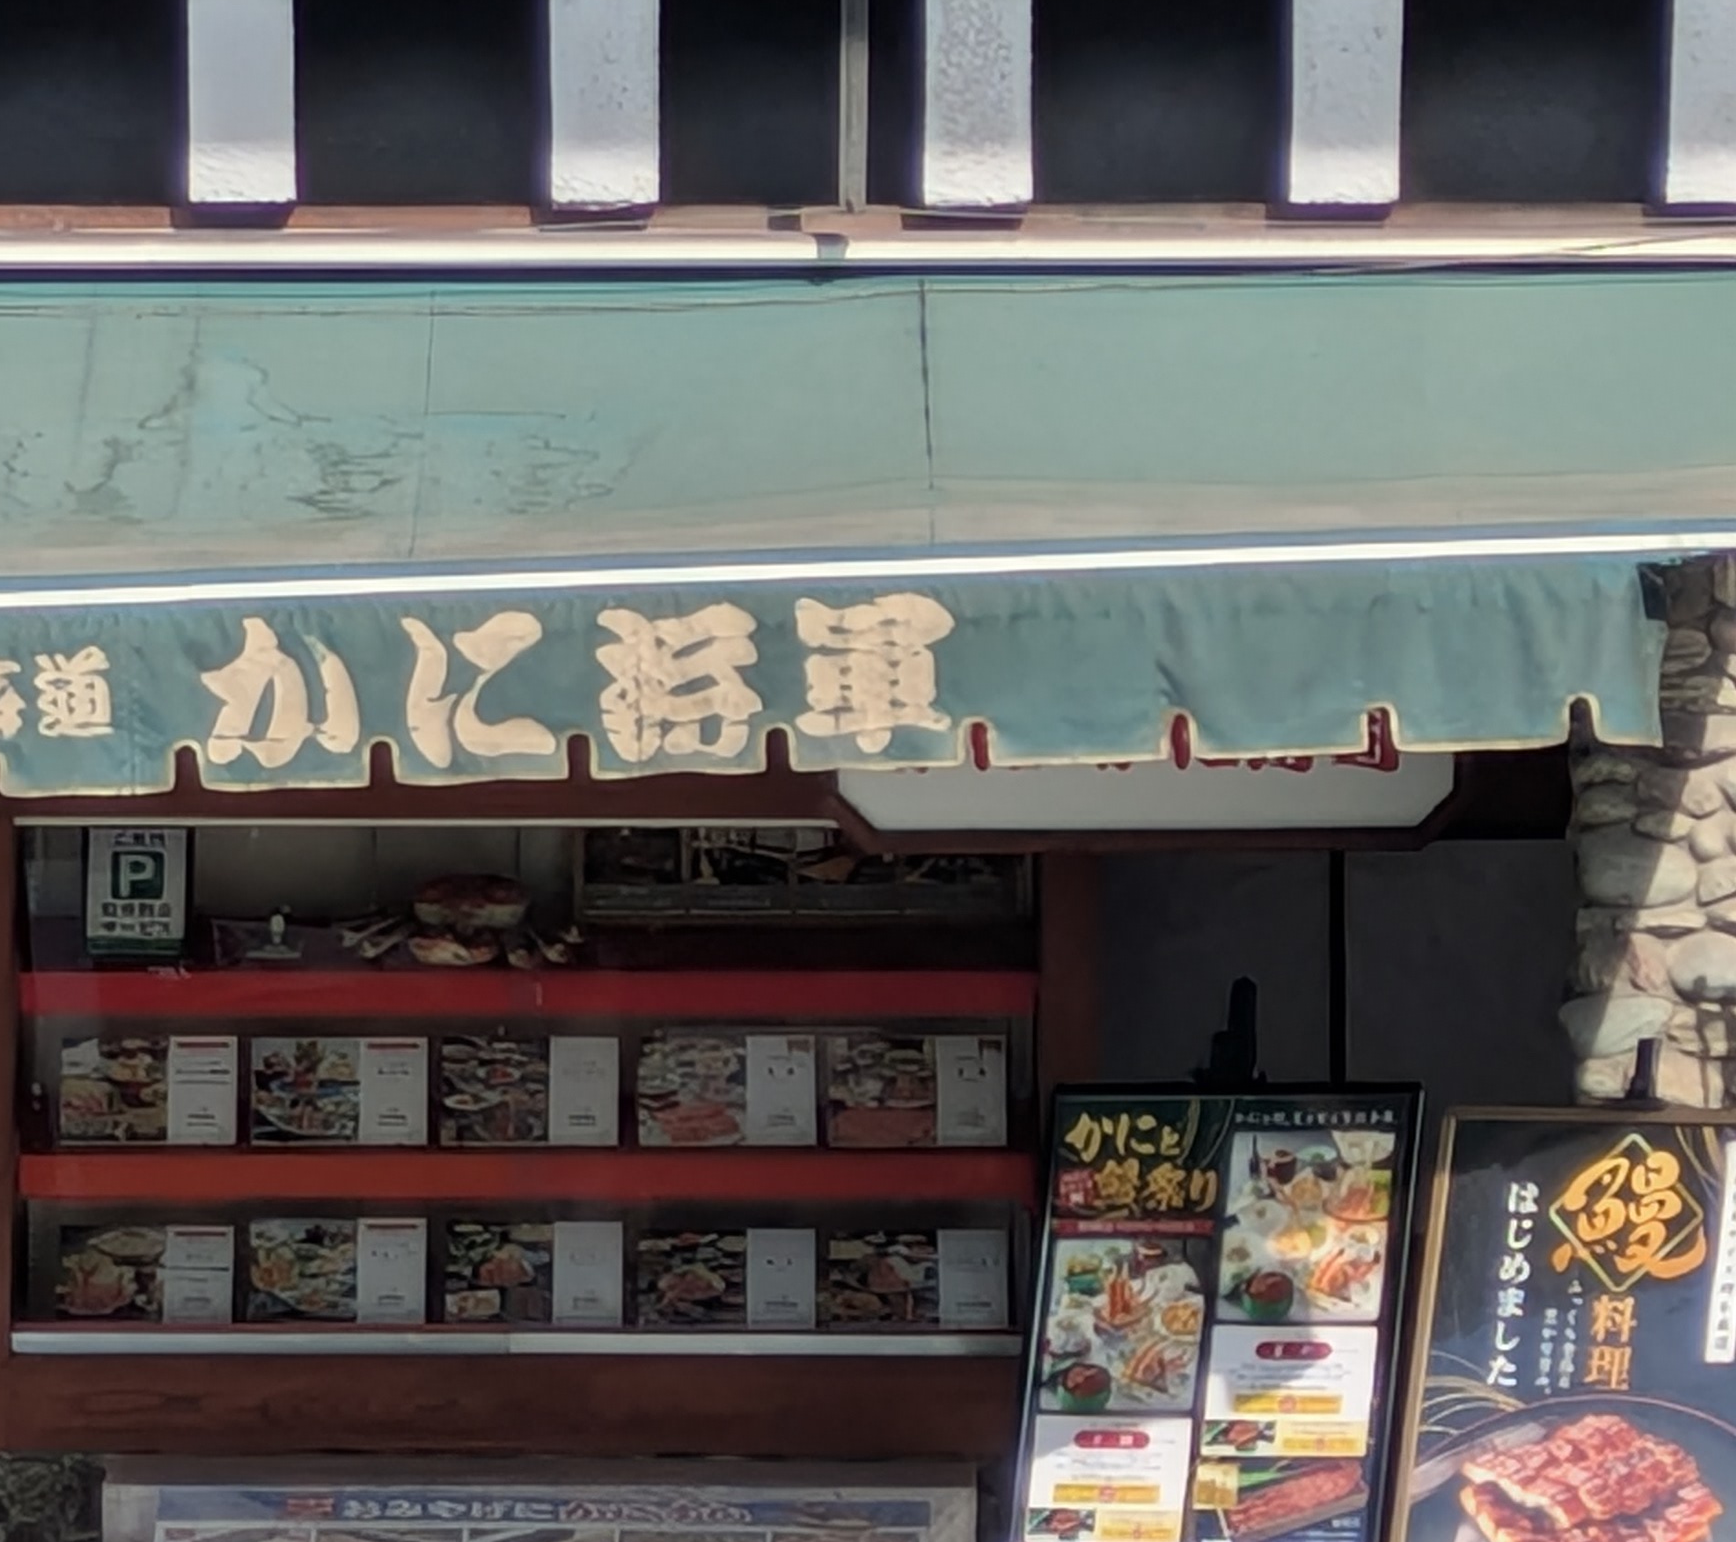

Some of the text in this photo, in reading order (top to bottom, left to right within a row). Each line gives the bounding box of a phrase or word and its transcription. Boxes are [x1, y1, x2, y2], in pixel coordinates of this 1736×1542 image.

[202, 591, 954, 766] かに将軍
[119, 854, 156, 898] P
[1065, 1112, 1181, 1163] かにと
[1486, 1181, 1540, 1387] はじめました
[1583, 1294, 1638, 1391] 料理
